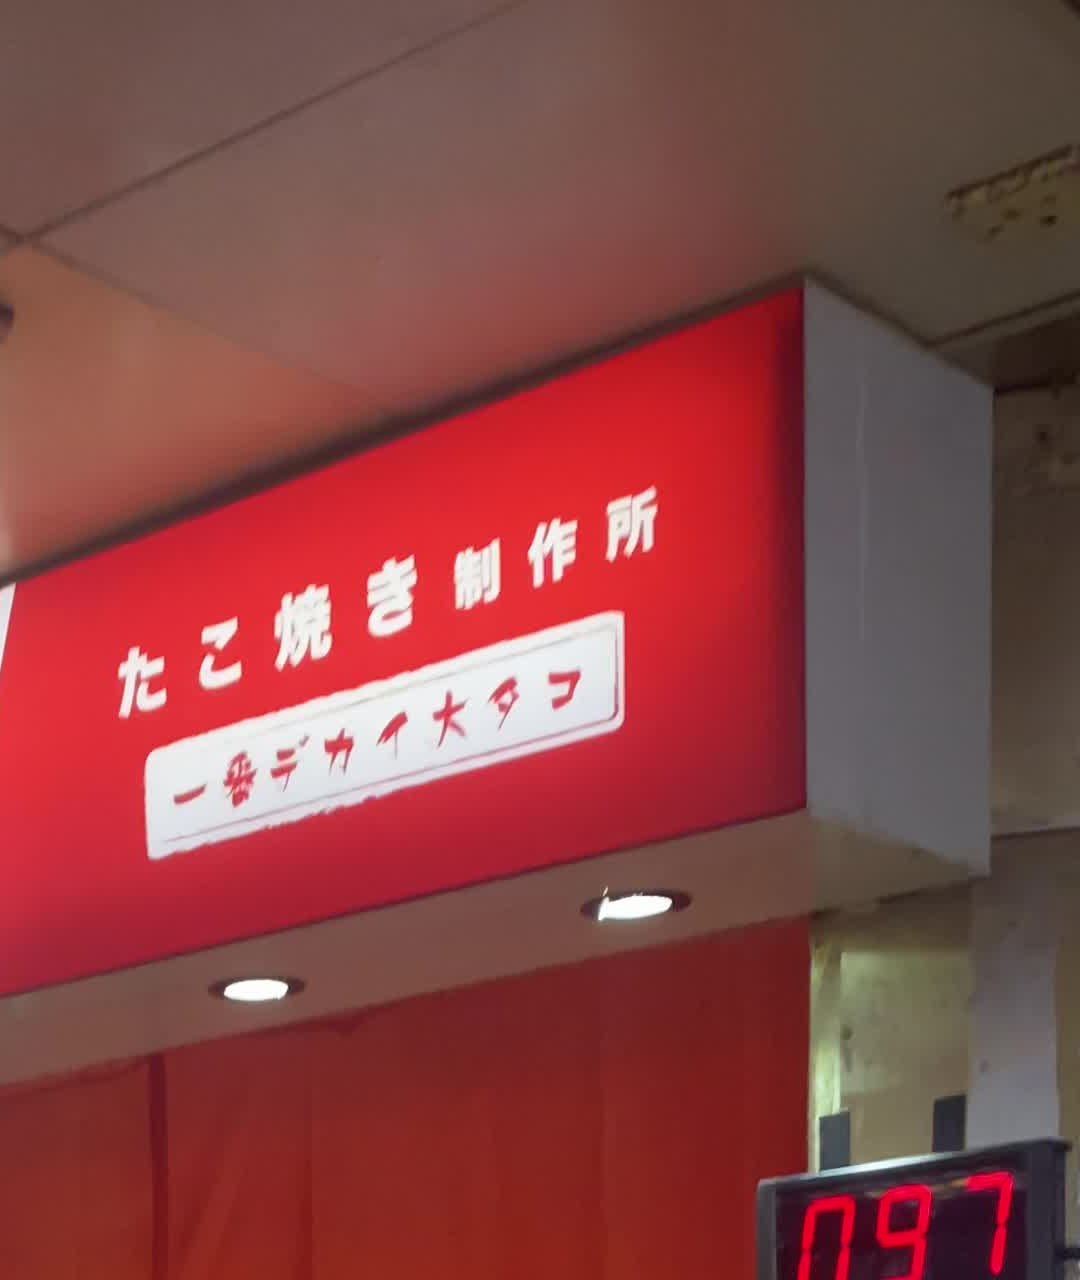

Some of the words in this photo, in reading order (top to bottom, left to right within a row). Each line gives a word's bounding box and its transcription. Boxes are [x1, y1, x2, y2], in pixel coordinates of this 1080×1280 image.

[118, 486, 658, 719] たこ焼き制作所
